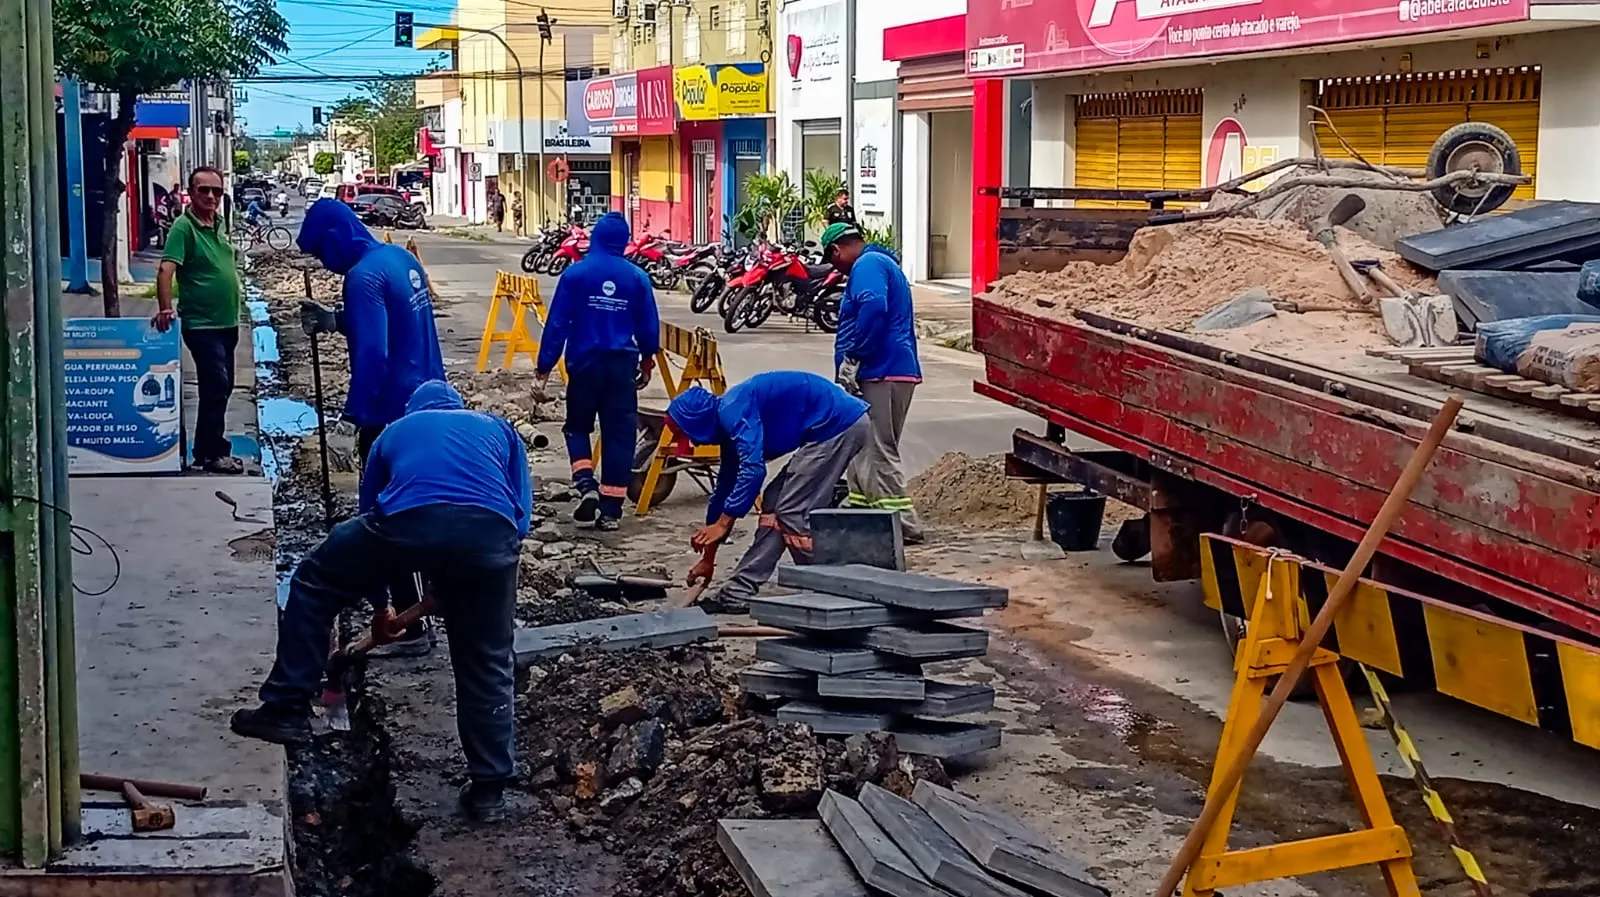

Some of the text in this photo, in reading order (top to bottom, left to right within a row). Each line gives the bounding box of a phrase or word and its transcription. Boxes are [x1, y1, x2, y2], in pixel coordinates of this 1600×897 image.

[1168, 11, 1301, 46] Você no ponto certo do atacado e varejo.
[683, 75, 707, 105] Popular
[720, 81, 764, 95] Popular
[586, 88, 613, 111] CARDOSO
[641, 80, 669, 119] MUSA
[544, 138, 591, 148] BRASILEIRA
[85, 363, 138, 371] PERFUMADA
[89, 375, 117, 383] LIMPA
[118, 375, 139, 383] PISO
[103, 424, 115, 432] DE
[116, 424, 138, 432] PISO
[75, 436, 145, 445] E MUITO MAIS...
